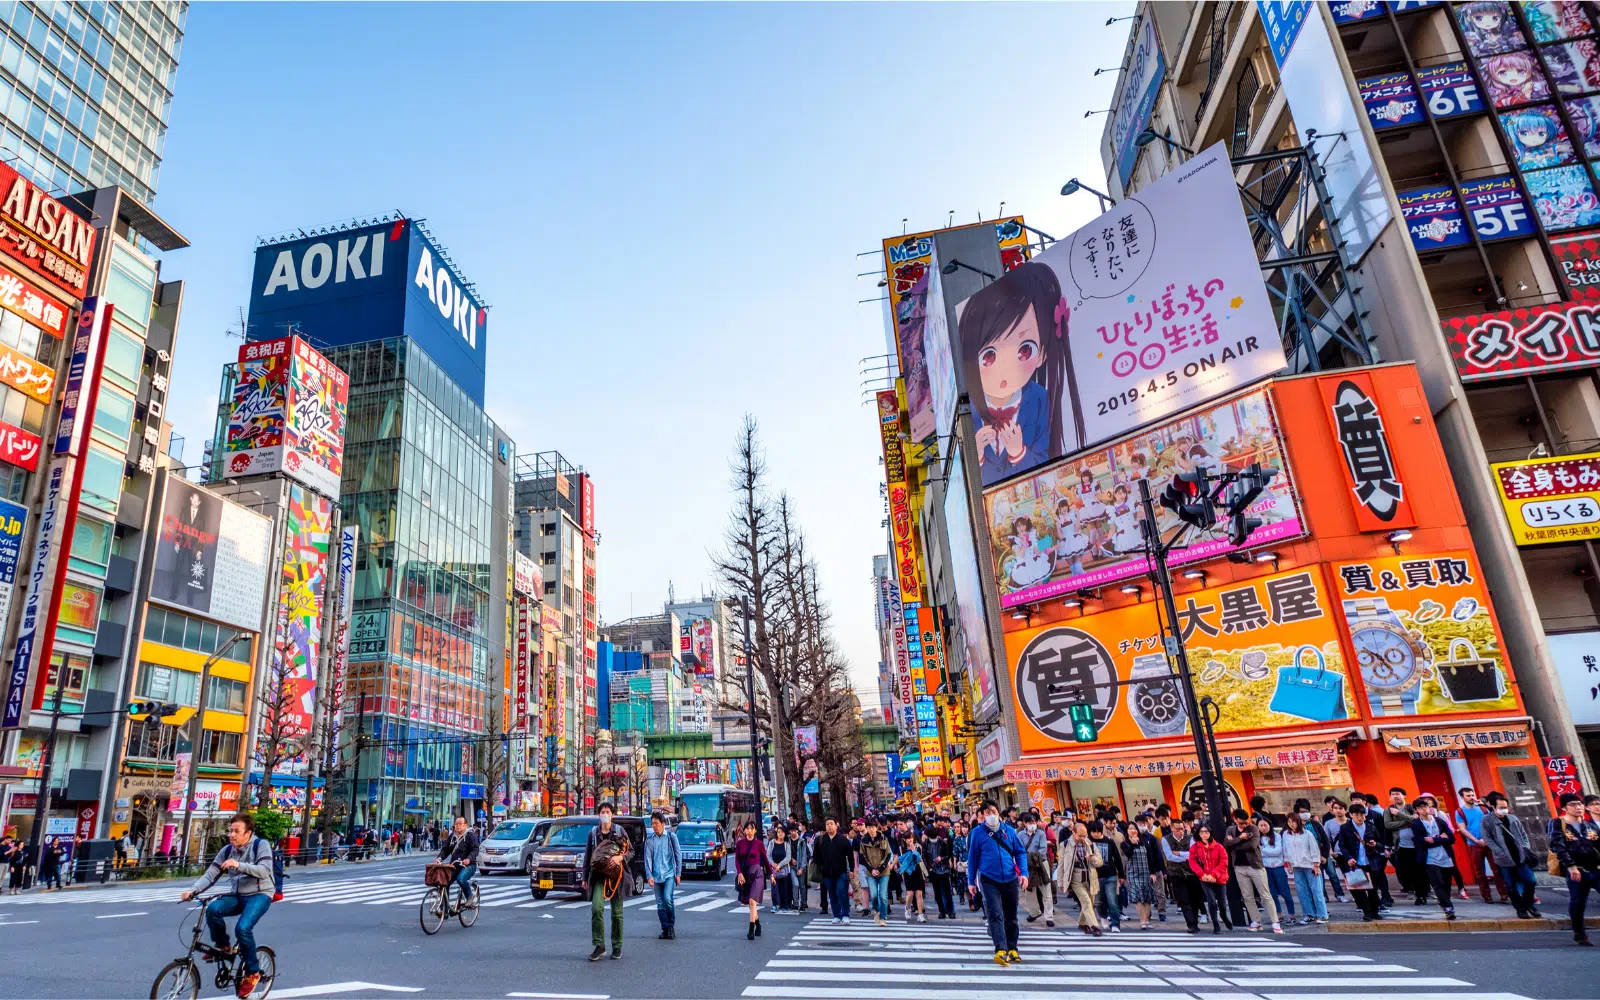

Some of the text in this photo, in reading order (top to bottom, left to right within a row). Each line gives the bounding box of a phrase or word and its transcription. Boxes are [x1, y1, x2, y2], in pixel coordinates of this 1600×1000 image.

[1428, 85, 1479, 115] 6F
[1183, 157, 1218, 180] KADOKAWA
[3, 176, 95, 267] AISAN
[1118, 214, 1140, 257] 友達に
[1473, 203, 1527, 235] 5F
[263, 232, 385, 296] AOKI
[1102, 228, 1124, 280] なりたい
[0, 274, 64, 331] 光通信
[415, 246, 477, 350] AOKI
[1097, 278, 1224, 347] ひとりぼっちの
[246, 341, 285, 359] 免税店
[1183, 336, 1259, 378] ON AIR
[1097, 370, 1178, 416] 2019.4.5
[139, 371, 167, 476] 坂口電熱
[1333, 398, 1403, 505] 質
[1251, 499, 1276, 513] cafe
[1528, 503, 1593, 521] りらくる
[165, 515, 217, 545] Change!
[342, 531, 354, 573] AKKY
[356, 615, 380, 628] 24h
[1178, 571, 1325, 642] 大黒屋
[355, 629, 379, 638] OPEN
[7, 640, 29, 718] AISAN
[900, 675, 911, 704] Shop
[1027, 637, 1114, 729] 質
[918, 711, 935, 719] DVD
[1276, 748, 1335, 765] 無料査定
[1549, 758, 1568, 772] 4F
[132, 779, 146, 787] Cafe
[222, 789, 236, 800] au
